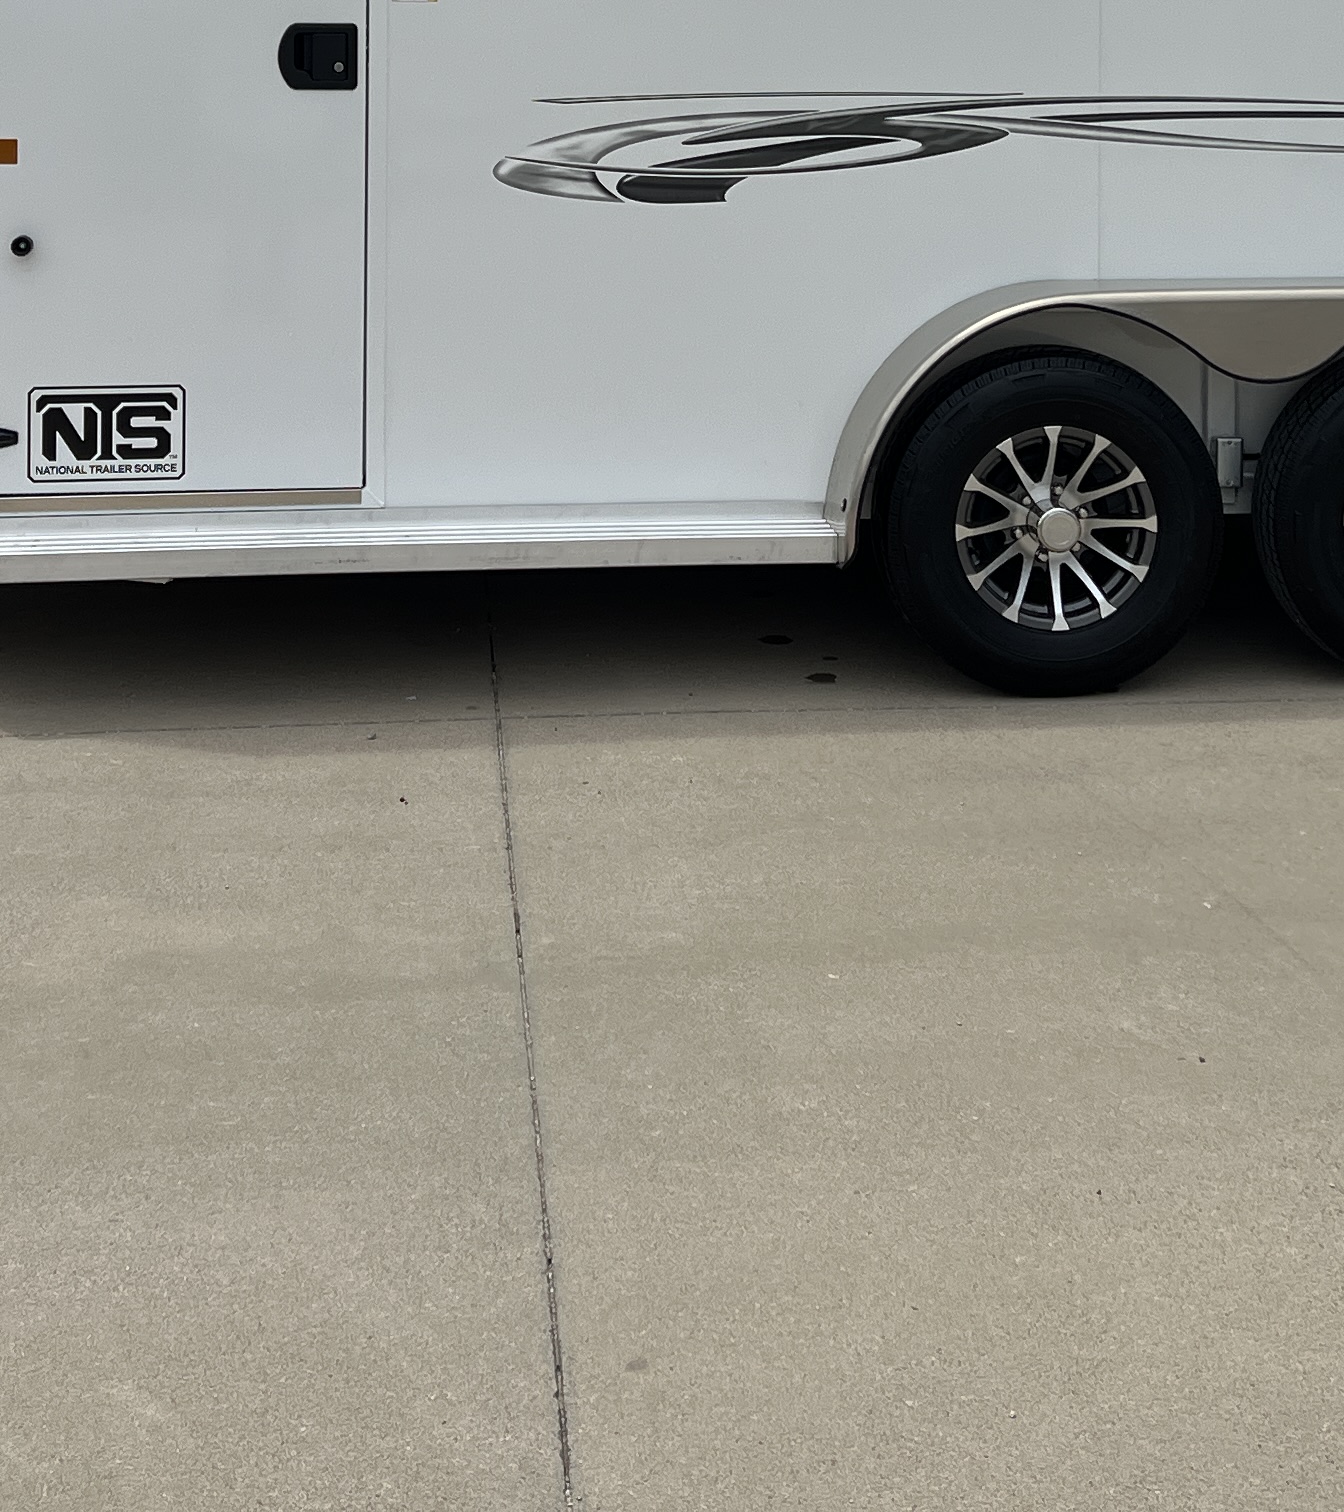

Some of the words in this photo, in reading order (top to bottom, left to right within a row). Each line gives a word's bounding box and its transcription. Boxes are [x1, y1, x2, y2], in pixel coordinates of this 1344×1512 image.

[35, 392, 178, 462] NTS
[35, 465, 87, 475] NATIONAL
[89, 464, 133, 474] TRAILER
[134, 463, 178, 473] SOURCE
